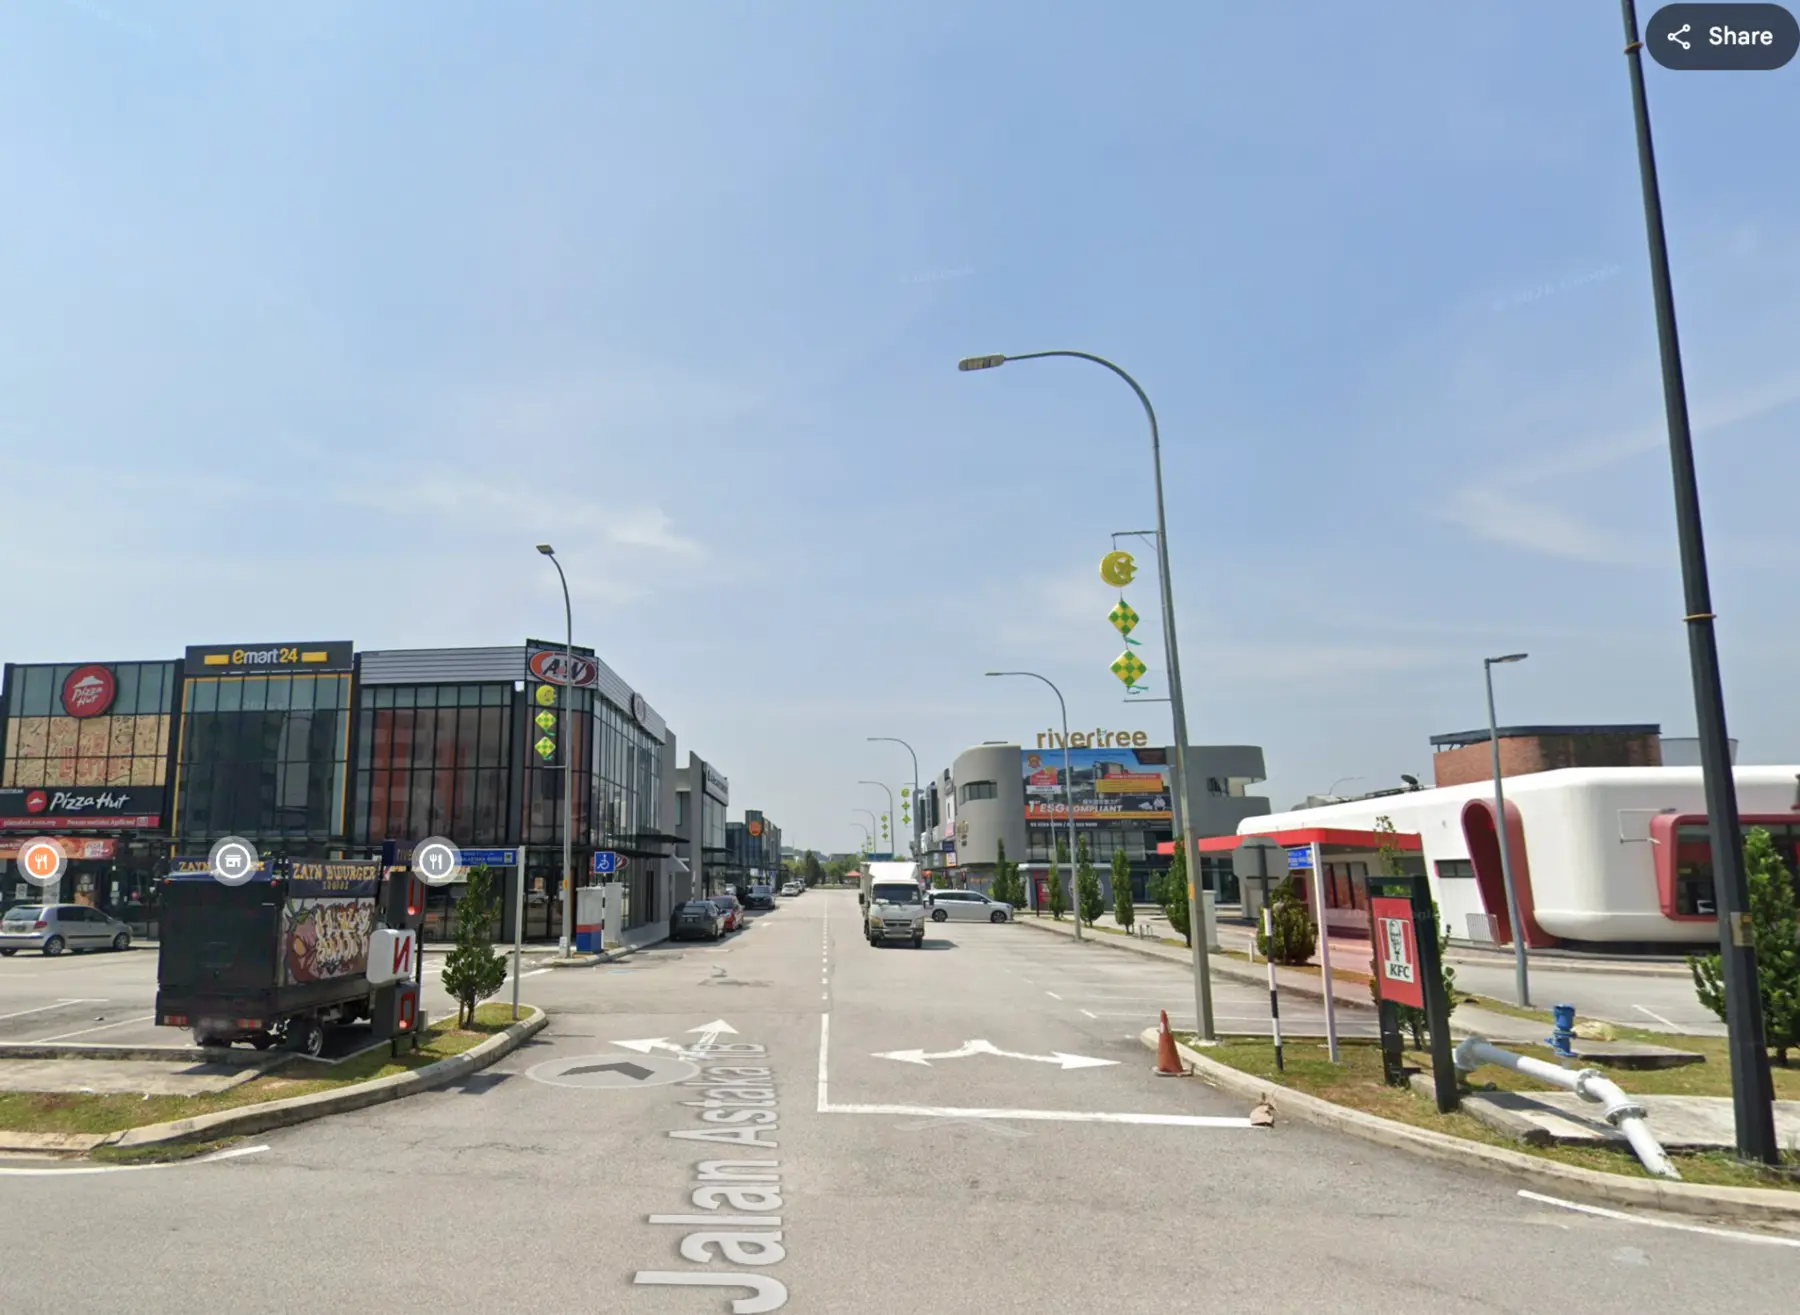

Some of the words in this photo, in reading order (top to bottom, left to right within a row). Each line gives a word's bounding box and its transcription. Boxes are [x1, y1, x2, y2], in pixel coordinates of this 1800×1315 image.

[232, 647, 298, 665] emart24
[1036, 728, 1148, 749] rivertree
[49, 791, 95, 811] Pizza
[93, 790, 130, 810] Hut
[1389, 963, 1410, 979] KFC
